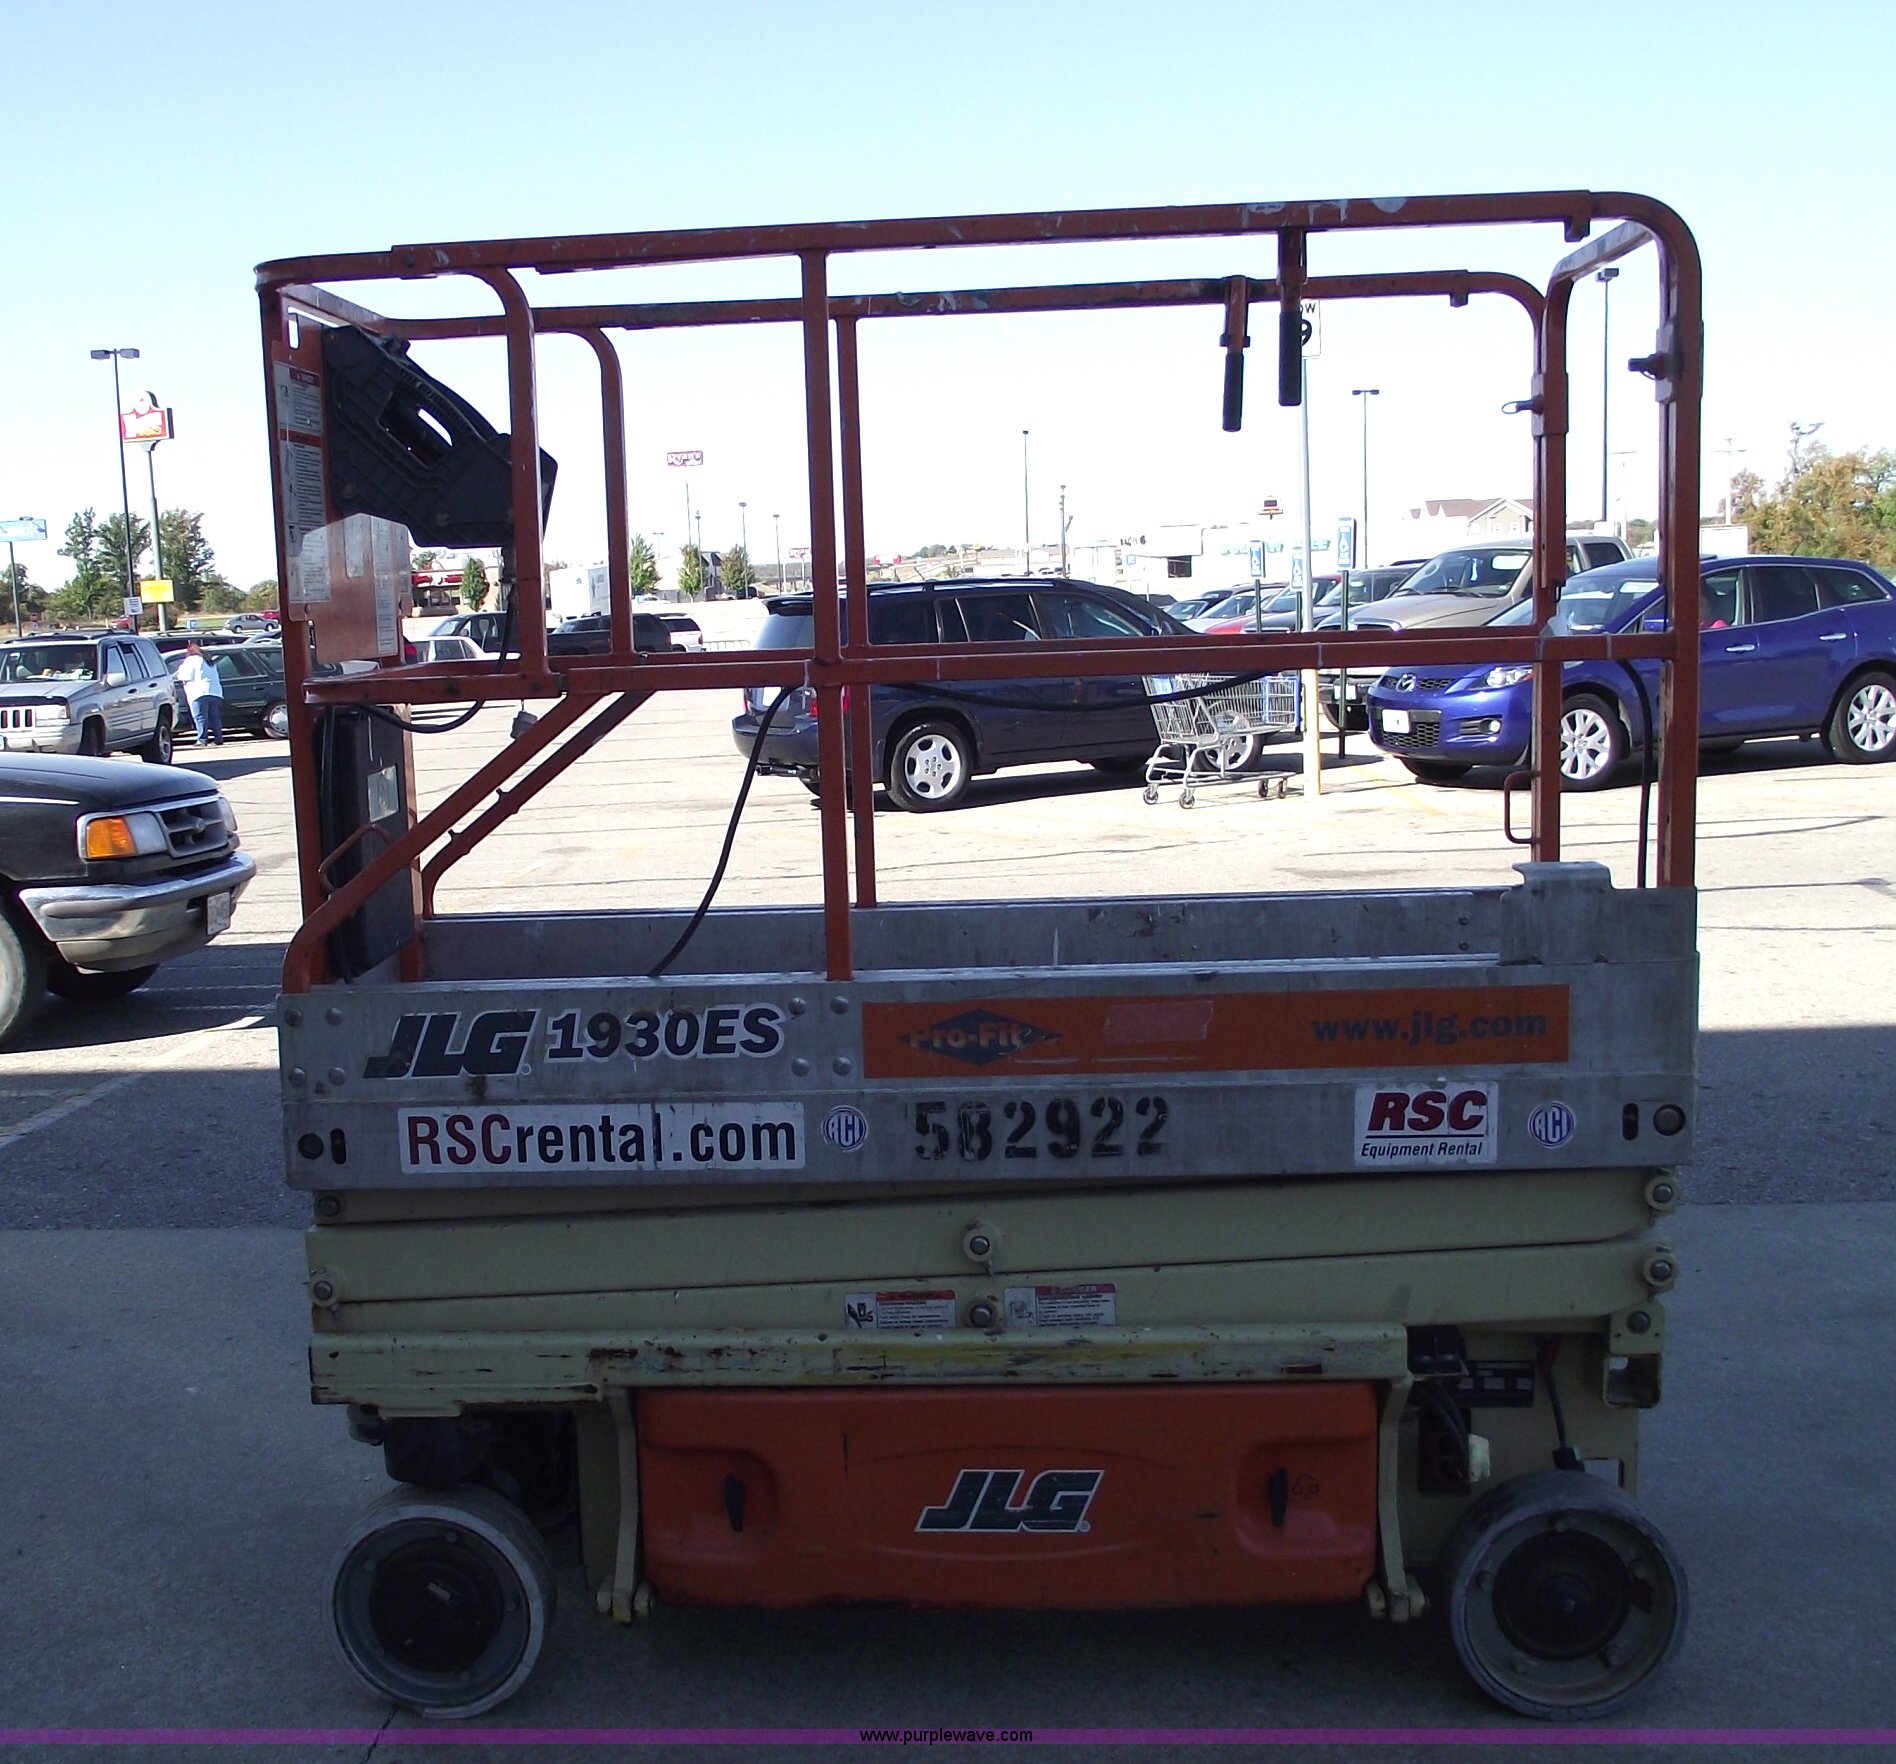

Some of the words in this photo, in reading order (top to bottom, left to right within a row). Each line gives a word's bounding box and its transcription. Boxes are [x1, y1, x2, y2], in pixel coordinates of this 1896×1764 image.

[364, 1009, 536, 1079] JLG
[547, 1004, 786, 1062] 1930ES
[908, 1020, 1025, 1050] Pro-Fit
[1312, 1009, 1547, 1047] www.jlg.com
[914, 1096, 1170, 1162] 582922
[1367, 1089, 1488, 1132] RSC
[407, 1108, 797, 1168] RSCrental.com
[1361, 1141, 1434, 1160] Equipment
[1437, 1140, 1483, 1157] Rental
[914, 1468, 1104, 1534] JLG
